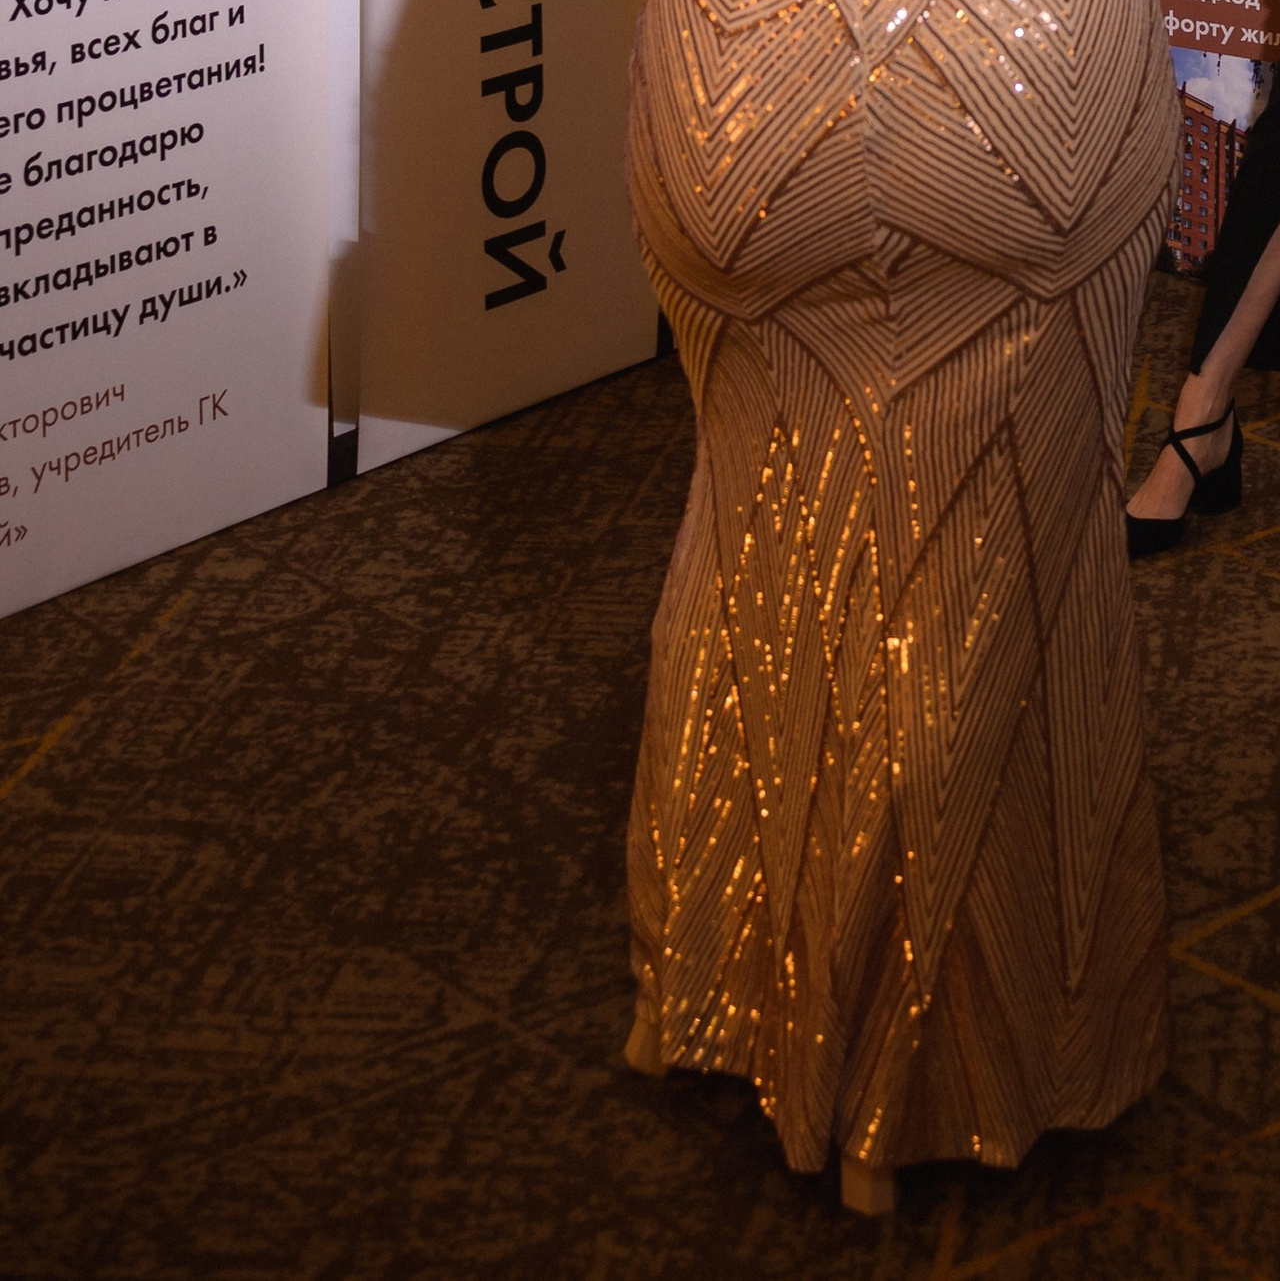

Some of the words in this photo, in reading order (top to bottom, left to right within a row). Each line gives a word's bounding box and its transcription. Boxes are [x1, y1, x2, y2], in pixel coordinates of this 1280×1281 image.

[71, 29, 142, 64] всех
[151, 11, 220, 44] благ
[228, 4, 245, 26] и
[57, 43, 266, 127] процветания!
[23, 122, 204, 188] благодарю
[203, 225, 218, 246] в
[139, 269, 248, 325] души.»
[30, 415, 190, 494] учредитель
[199, 389, 229, 425] ГК
